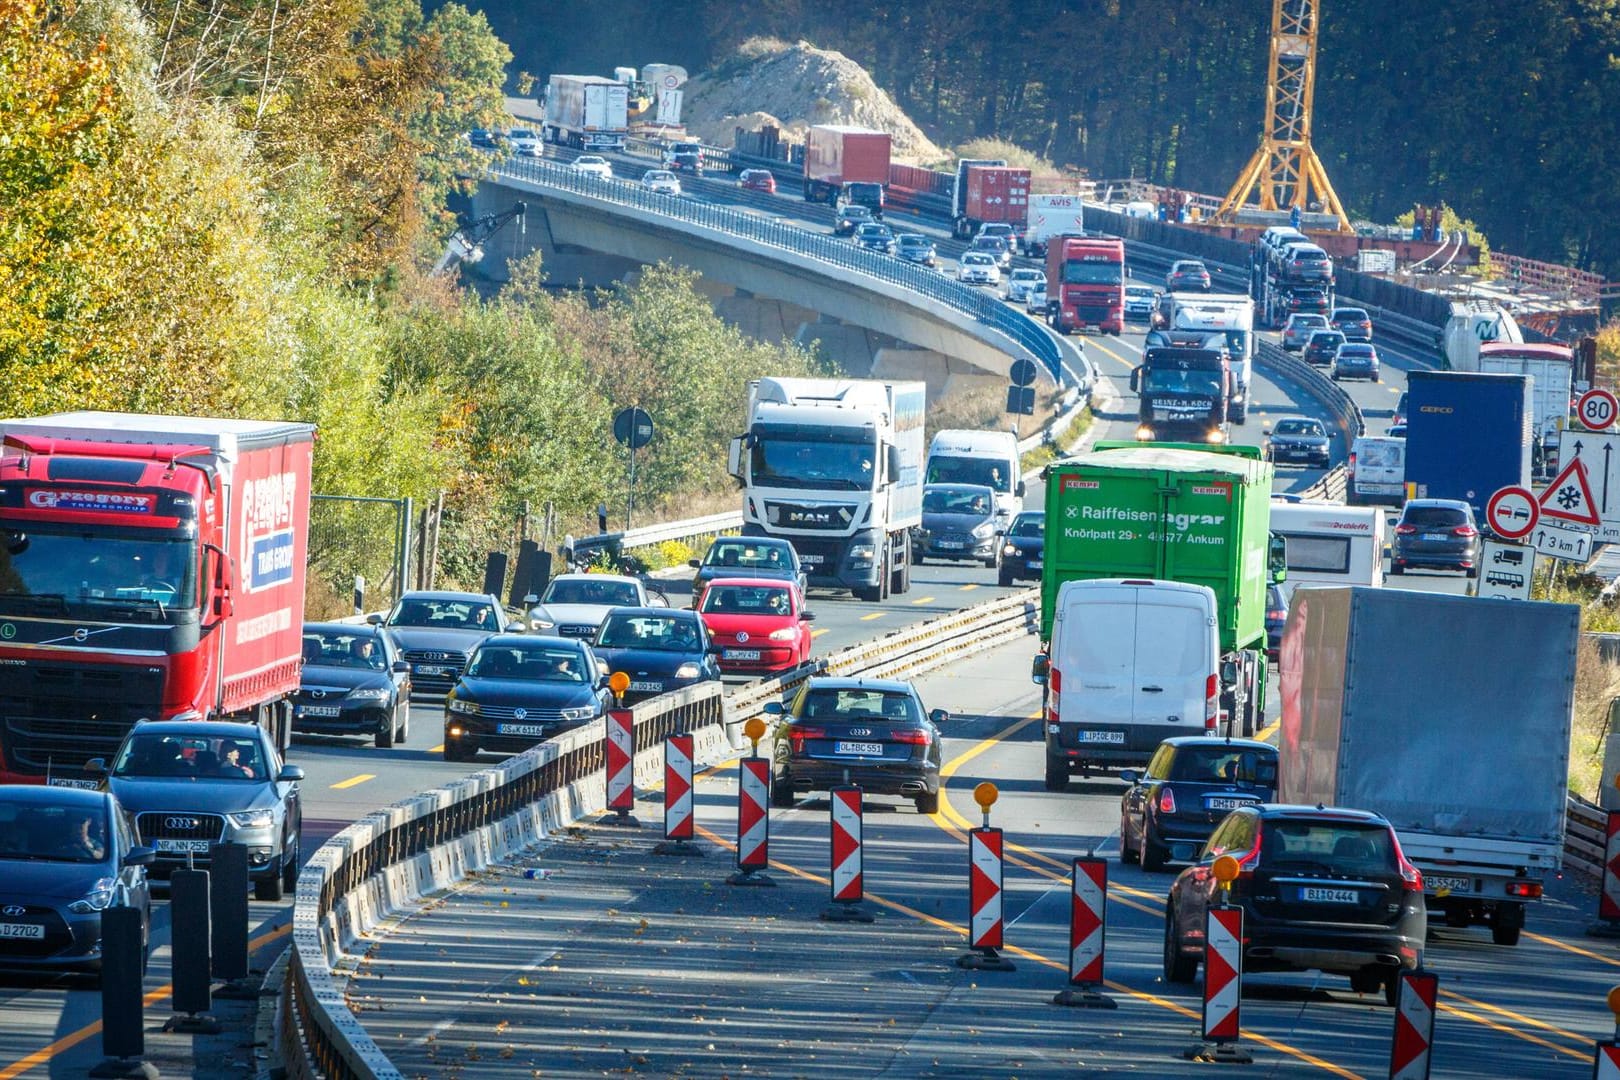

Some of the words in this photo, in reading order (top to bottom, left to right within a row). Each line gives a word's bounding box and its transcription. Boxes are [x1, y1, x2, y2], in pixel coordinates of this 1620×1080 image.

[1586, 401, 1609, 419] 80
[29, 490, 150, 508] Grzegory
[790, 512, 829, 522] MAN
[1082, 506, 1157, 522] Raiffeisen
[1162, 513, 1225, 531] agrar
[1065, 527, 1115, 541] Knörlpatt
[1186, 535, 1224, 545] Ankum
[1603, 527, 1619, 537] km
[1548, 537, 1557, 547] 3
[1558, 539, 1573, 551] km
[855, 744, 866, 752] BC
[867, 744, 882, 753] 551
[158, 841, 170, 850] NR
[190, 842, 208, 851] 255
[1308, 889, 1320, 899] BI
[1335, 892, 1354, 902] 444
[12, 925, 39, 937] 2702
